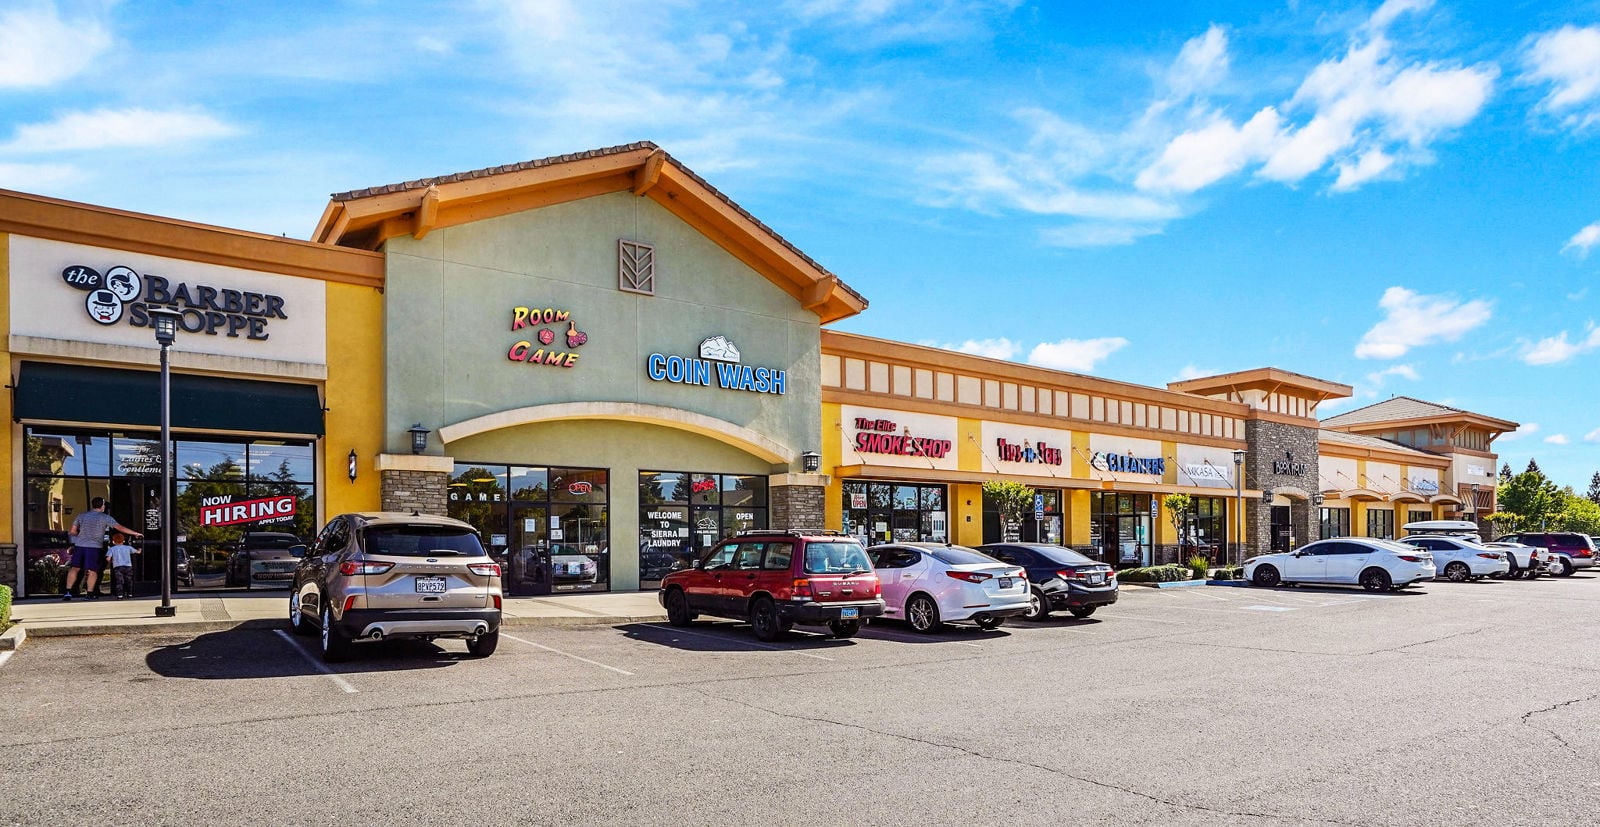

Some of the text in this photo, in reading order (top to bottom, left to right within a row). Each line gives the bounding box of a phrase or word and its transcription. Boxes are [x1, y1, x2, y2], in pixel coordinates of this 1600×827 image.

[66, 268, 98, 286] the
[143, 274, 288, 320] BARBER
[129, 302, 269, 341] SOPPE
[512, 306, 570, 331] ROOM
[508, 340, 580, 368] GAME
[647, 352, 786, 395] COIN WASH
[854, 432, 952, 458] SMOKE SHOP
[1106, 452, 1165, 475] CLEANERS
[569, 483, 592, 493] OPEN
[202, 495, 232, 507] NOW
[450, 492, 501, 502] GAME
[205, 498, 292, 525] HIRING
[647, 511, 682, 519] WELCOME
[736, 512, 754, 520] OPEN
[258, 515, 295, 526] APPLY TODAY
[660, 520, 670, 528] TO
[651, 530, 678, 538] SIERRA
[648, 539, 681, 547] LAUNDRY
